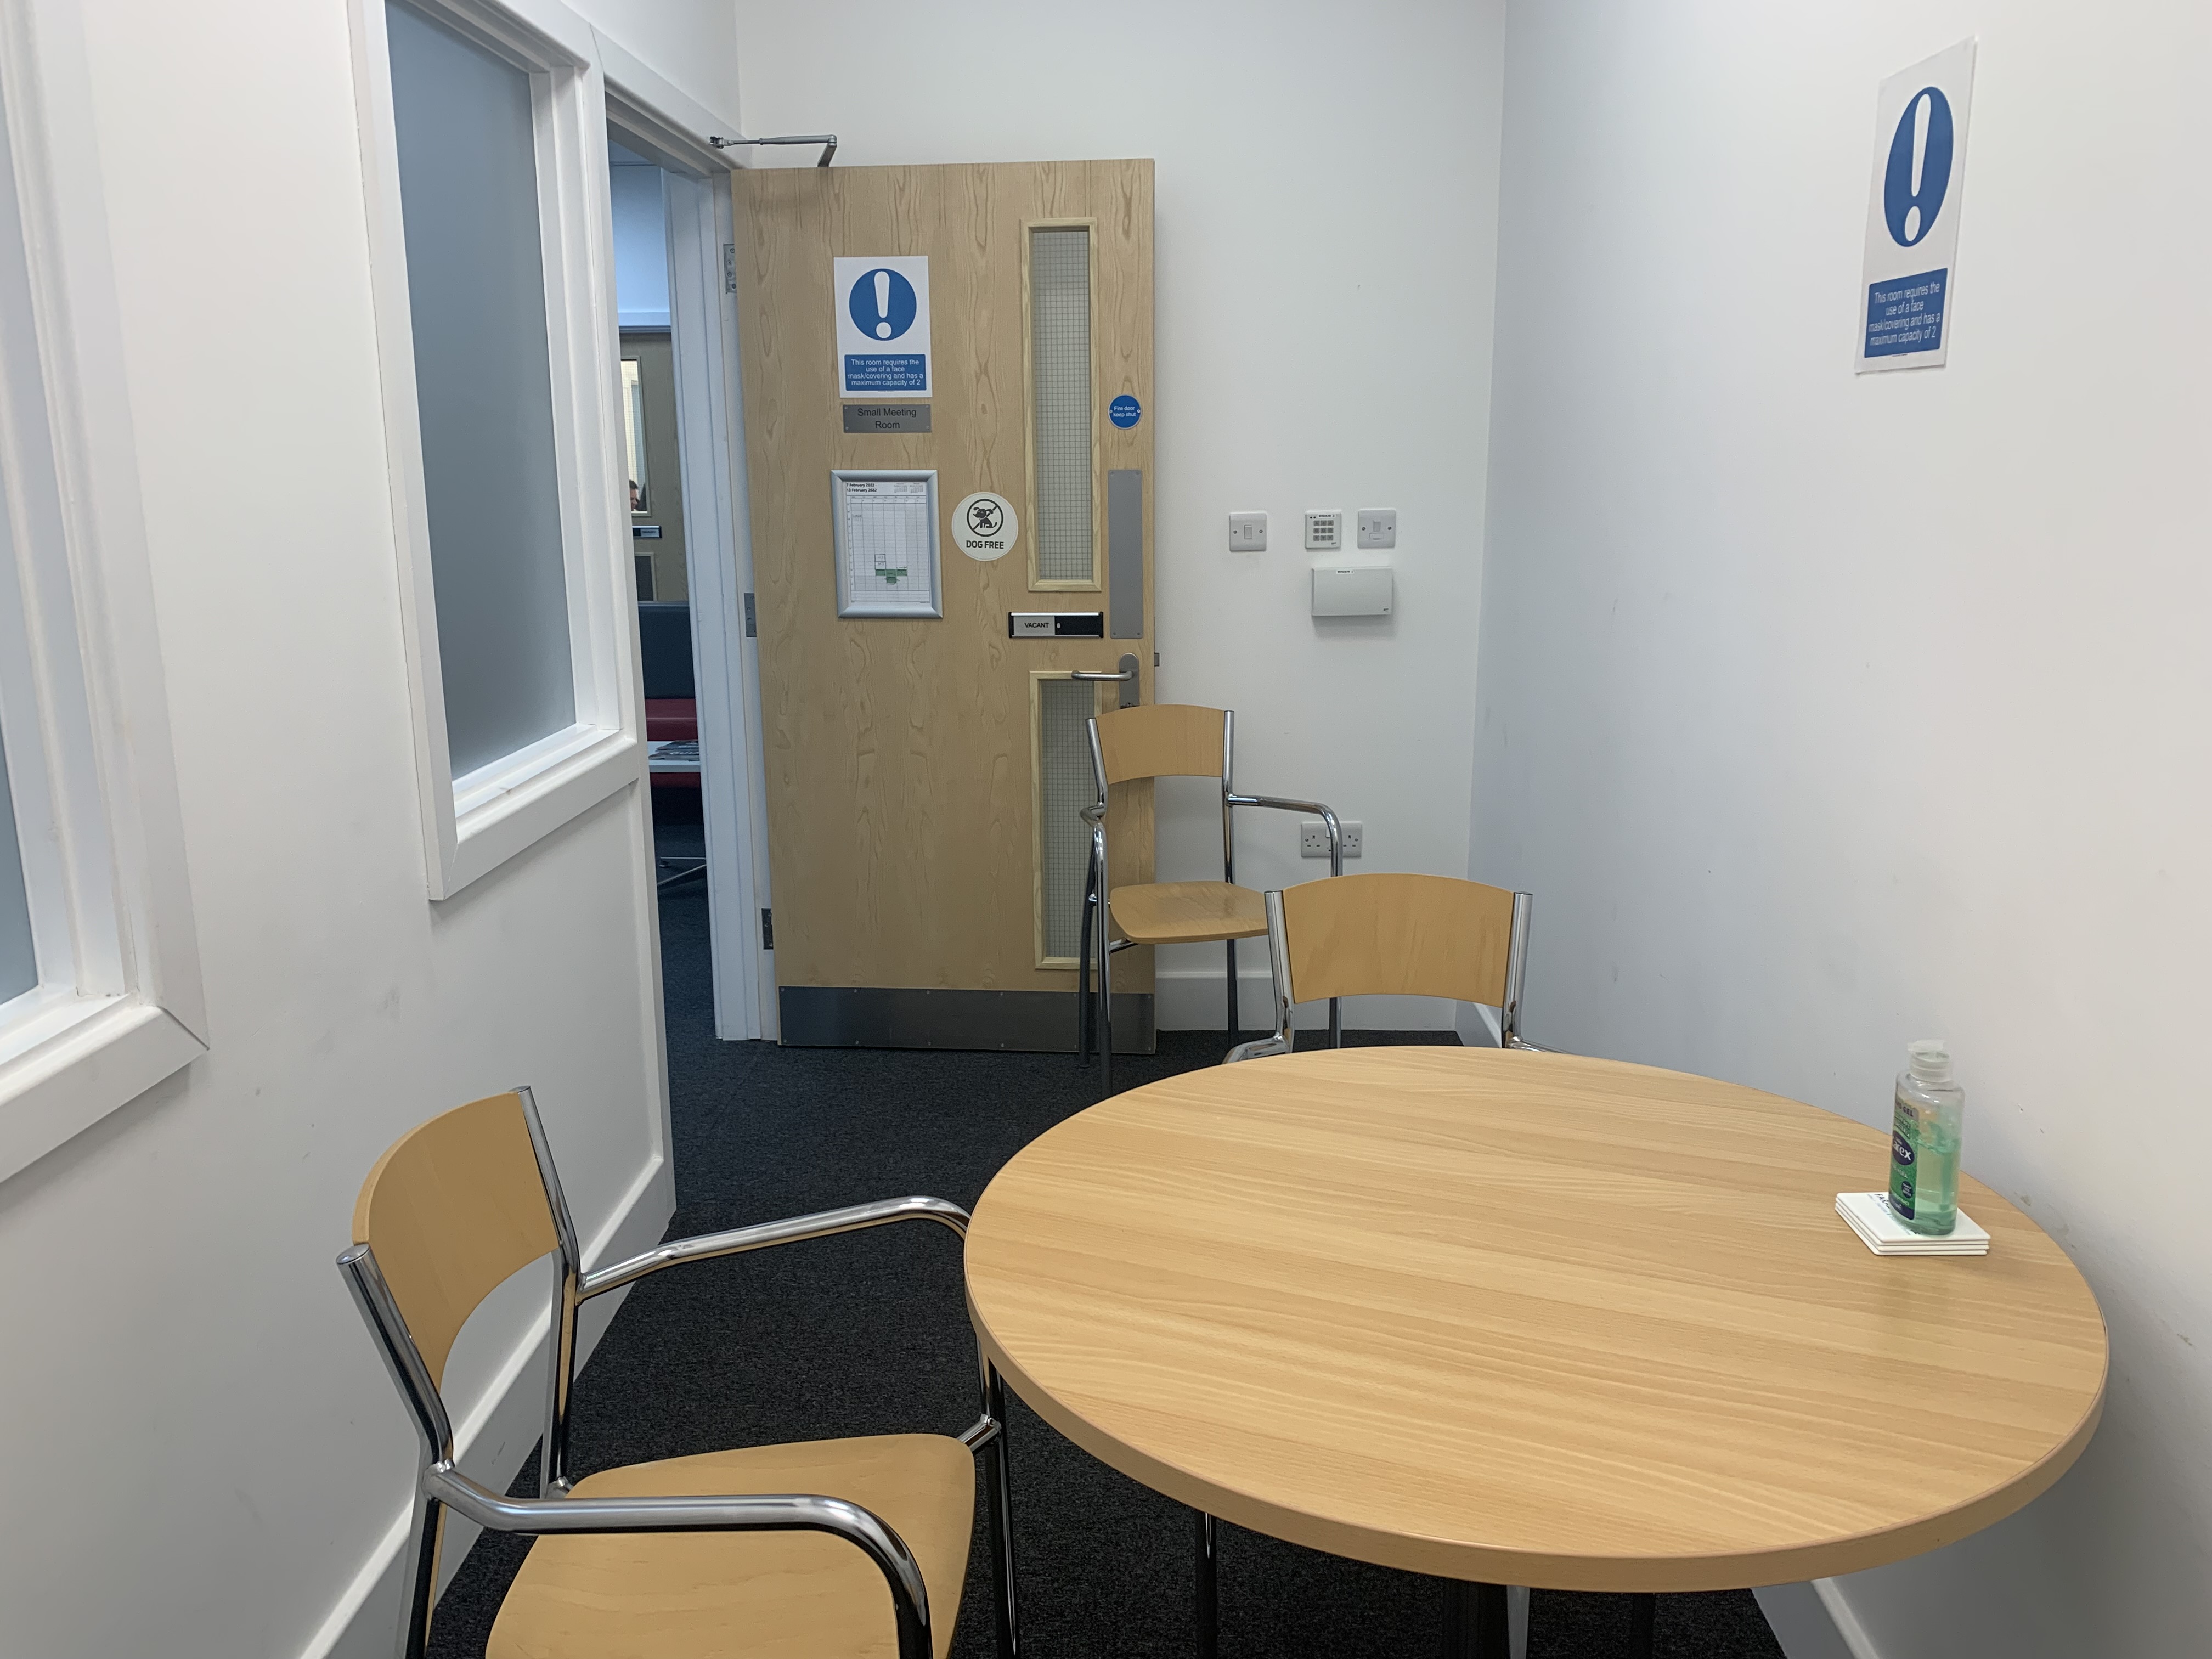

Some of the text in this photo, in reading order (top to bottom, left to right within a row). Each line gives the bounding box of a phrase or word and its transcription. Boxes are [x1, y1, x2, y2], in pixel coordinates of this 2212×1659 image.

[1874, 281, 1940, 303] This room requires the
[1886, 299, 1924, 316] use of a face
[1869, 313, 1940, 332] mask/covering and has a
[1870, 326, 1936, 346] maximum capacity of 2
[857, 408, 916, 418] Small Meeting
[984, 541, 1004, 549] FREE
[1903, 1106, 1913, 1116] GEL
